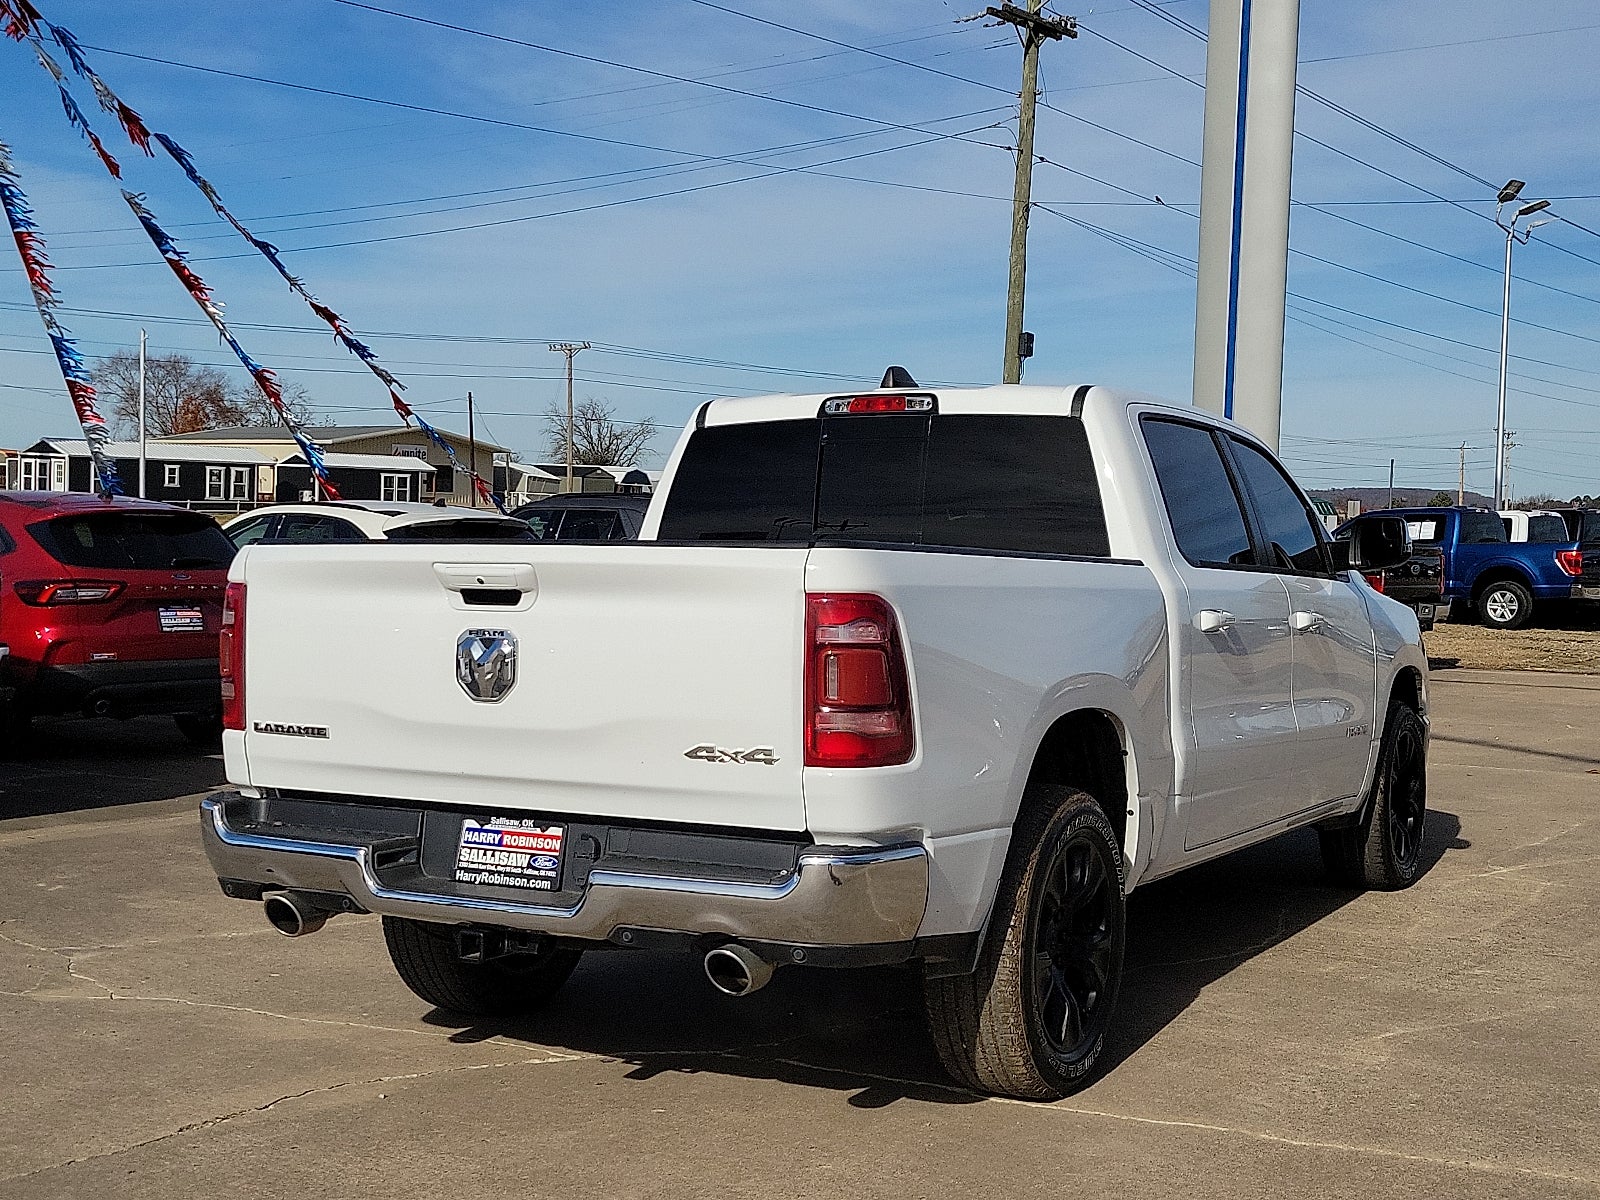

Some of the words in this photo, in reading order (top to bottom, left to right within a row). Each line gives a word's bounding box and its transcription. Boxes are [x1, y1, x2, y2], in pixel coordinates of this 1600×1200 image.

[253, 721, 331, 739] LARAMIE
[521, 819, 535, 828] OK
[463, 830, 502, 845] HARRY
[502, 834, 562, 851] ROBINSON
[459, 847, 532, 868] SALLISAW
[455, 869, 551, 890] HarryRobinson.com
